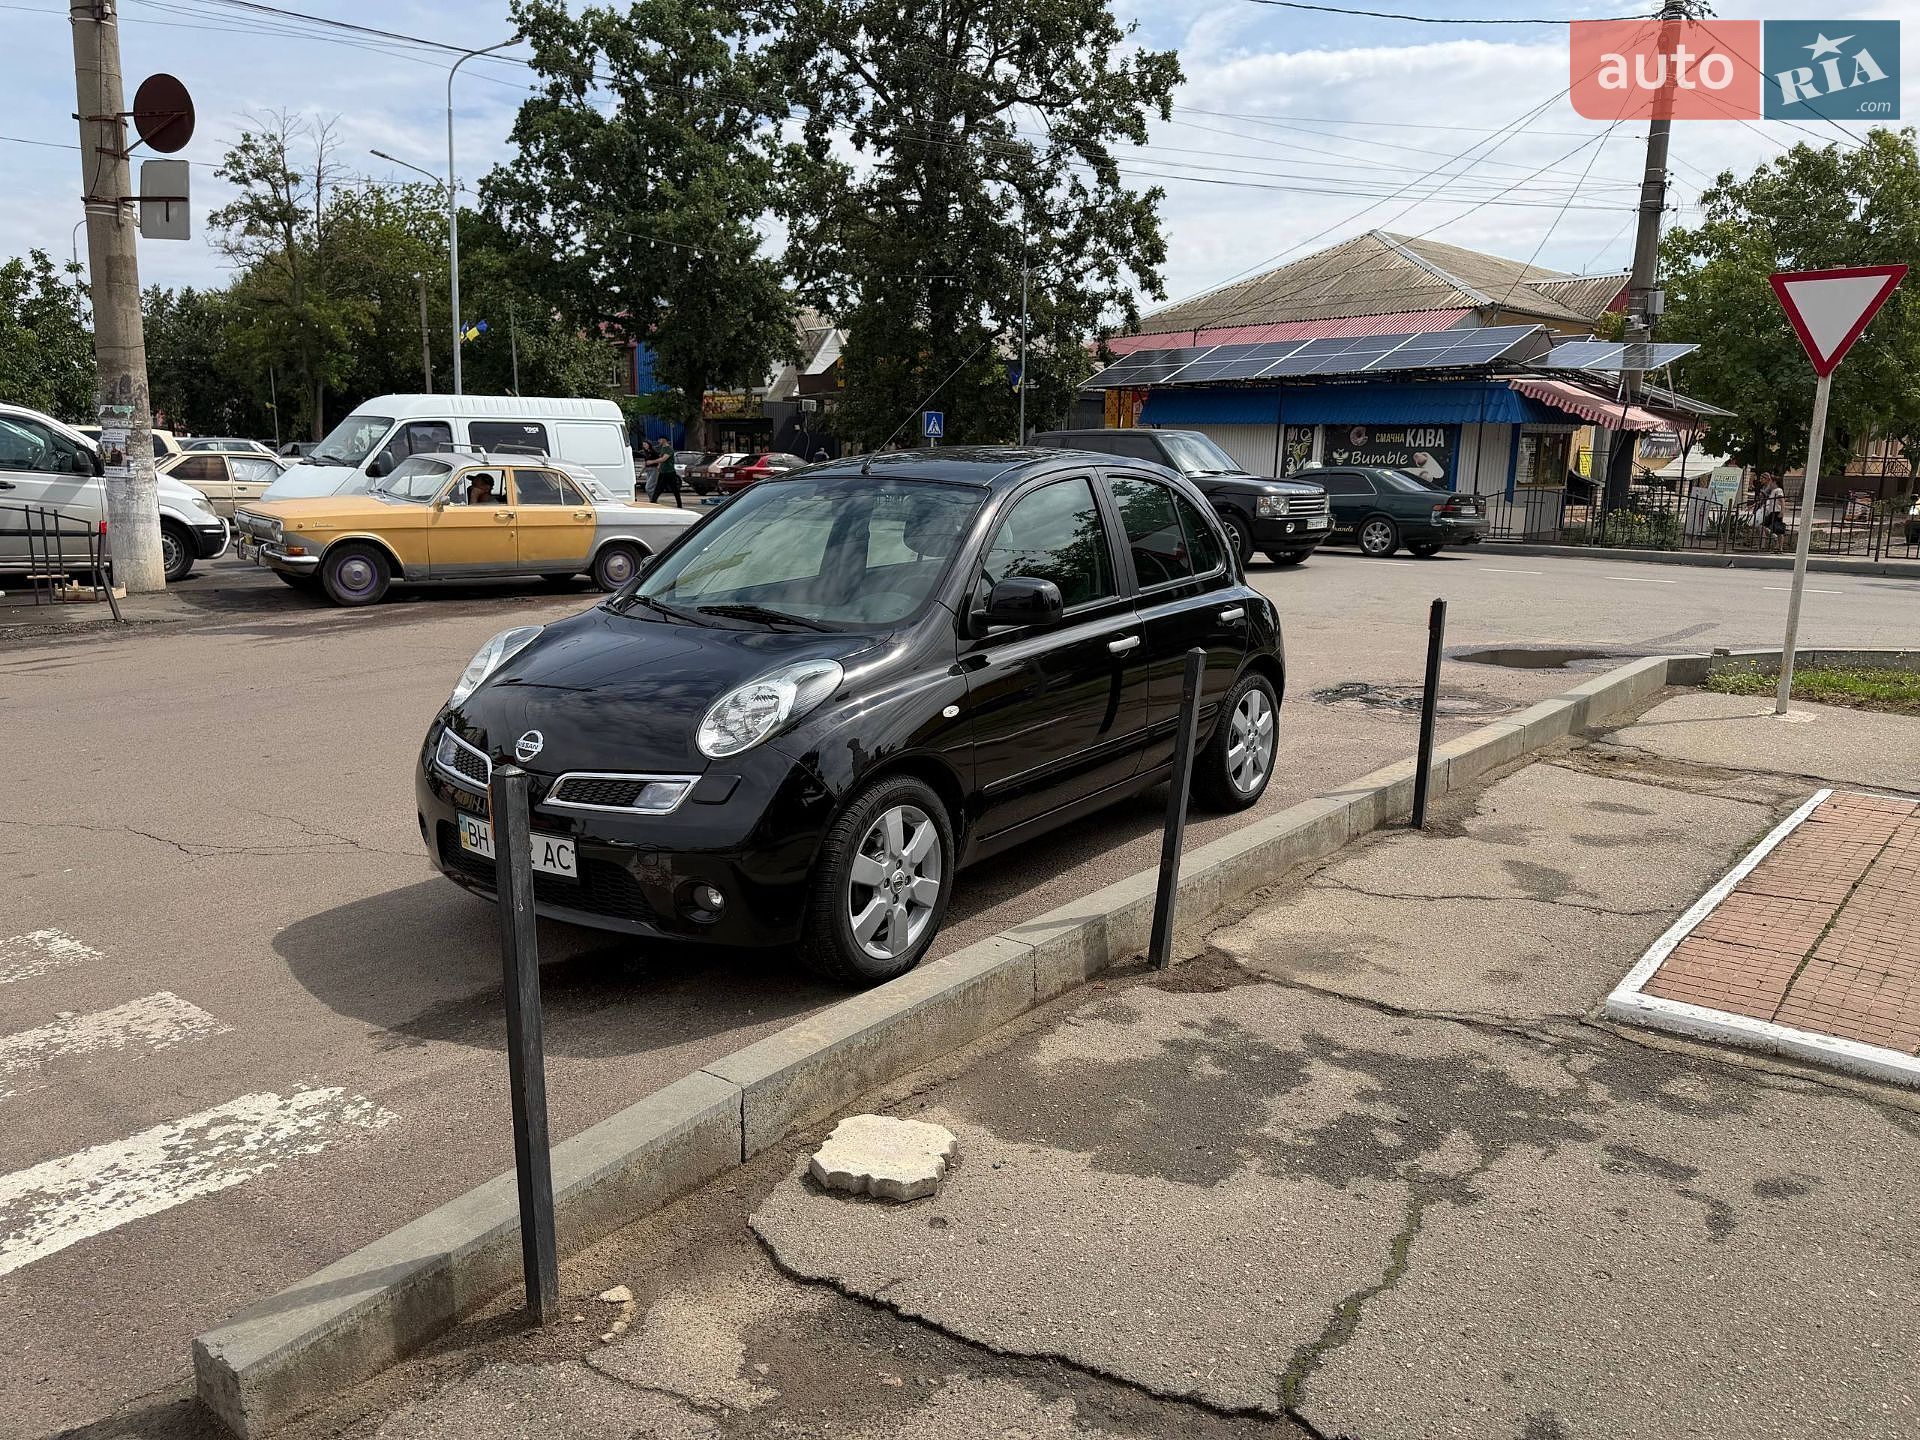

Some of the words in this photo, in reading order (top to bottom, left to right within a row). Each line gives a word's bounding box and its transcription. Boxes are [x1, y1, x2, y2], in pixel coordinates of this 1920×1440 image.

[1375, 433, 1405, 443] СМАЧНА
[1405, 428, 1445, 448] КАВА
[1350, 451, 1409, 465] Bumble
[517, 741, 539, 750] NISSAN
[467, 821, 490, 853] BH
[543, 841, 572, 870] AC
